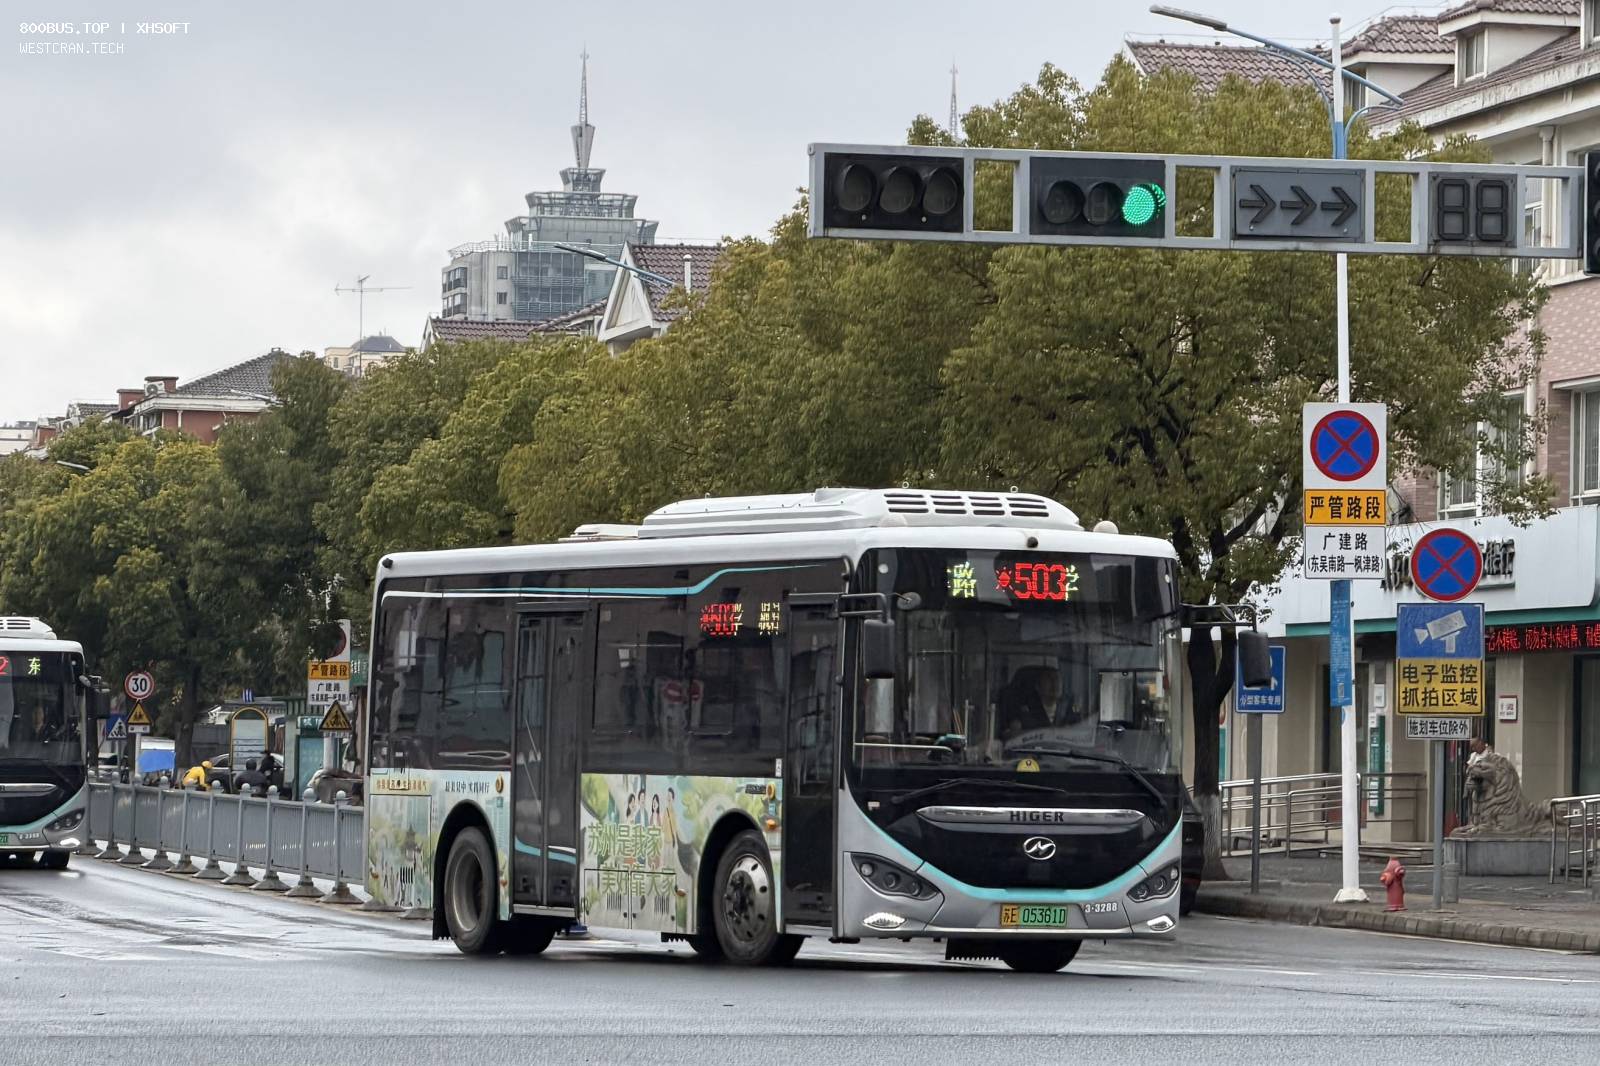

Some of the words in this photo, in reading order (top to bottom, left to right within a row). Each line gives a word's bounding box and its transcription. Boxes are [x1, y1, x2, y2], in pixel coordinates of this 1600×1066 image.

[1309, 495, 1380, 519] 严管路段
[1323, 532, 1367, 550] 广建路
[1014, 562, 1067, 600] 503
[310, 664, 347, 676] 严管路段
[1402, 664, 1478, 684] 电子监控
[131, 677, 148, 692] 30
[1402, 687, 1478, 707] 抓拍区域
[1409, 720, 1468, 736] 施划车位除外
[1010, 810, 1064, 822] HIGER
[587, 823, 662, 858] 苏州是我家
[1022, 908, 1066, 924] 05361D
